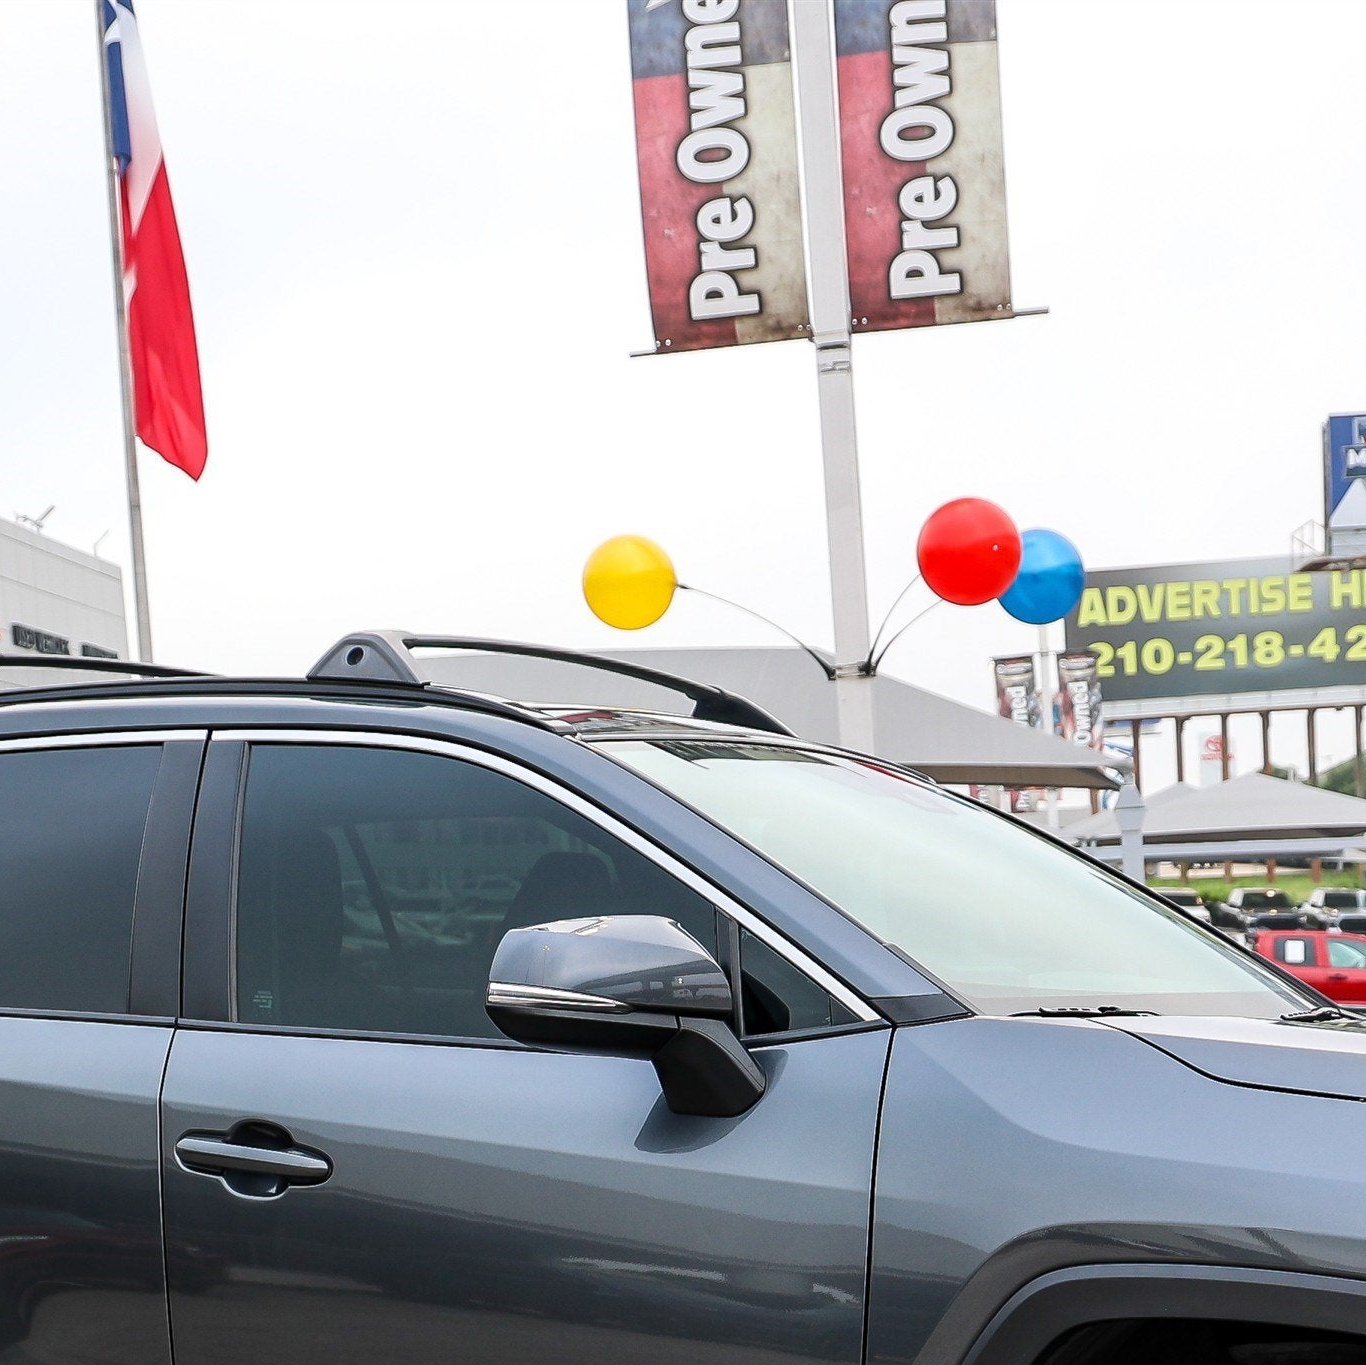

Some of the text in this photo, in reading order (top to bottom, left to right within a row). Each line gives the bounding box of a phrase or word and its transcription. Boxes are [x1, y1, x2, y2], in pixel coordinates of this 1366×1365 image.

[690, 197, 762, 324] Pre
[889, 175, 962, 300] Pre
[1077, 572, 1315, 628] ADVERTISE
